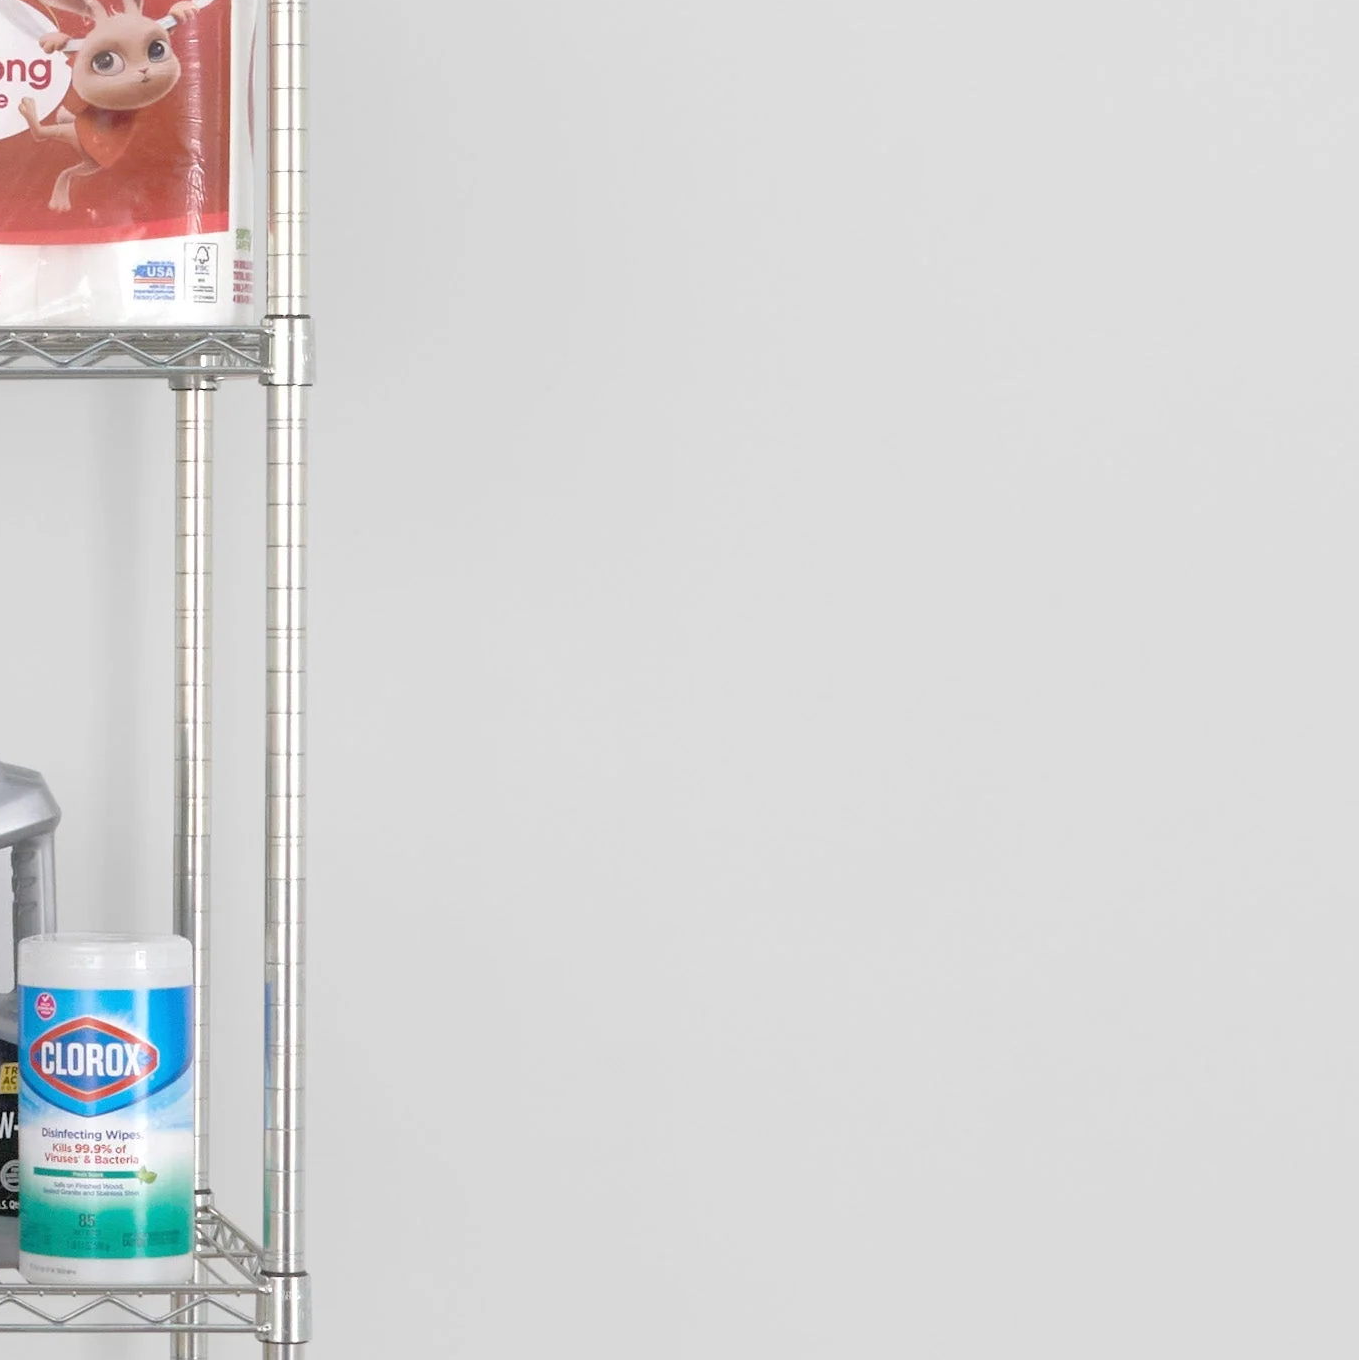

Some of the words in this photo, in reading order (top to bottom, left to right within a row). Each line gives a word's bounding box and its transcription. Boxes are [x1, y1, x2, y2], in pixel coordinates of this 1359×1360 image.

[147, 267, 174, 277] USA
[41, 1042, 141, 1077] CLOROX
[42, 1127, 102, 1141] Disinfecting
[53, 1143, 71, 1153] Kills
[75, 1144, 112, 1153] 99.9%
[95, 1155, 139, 1164] Bacteria
